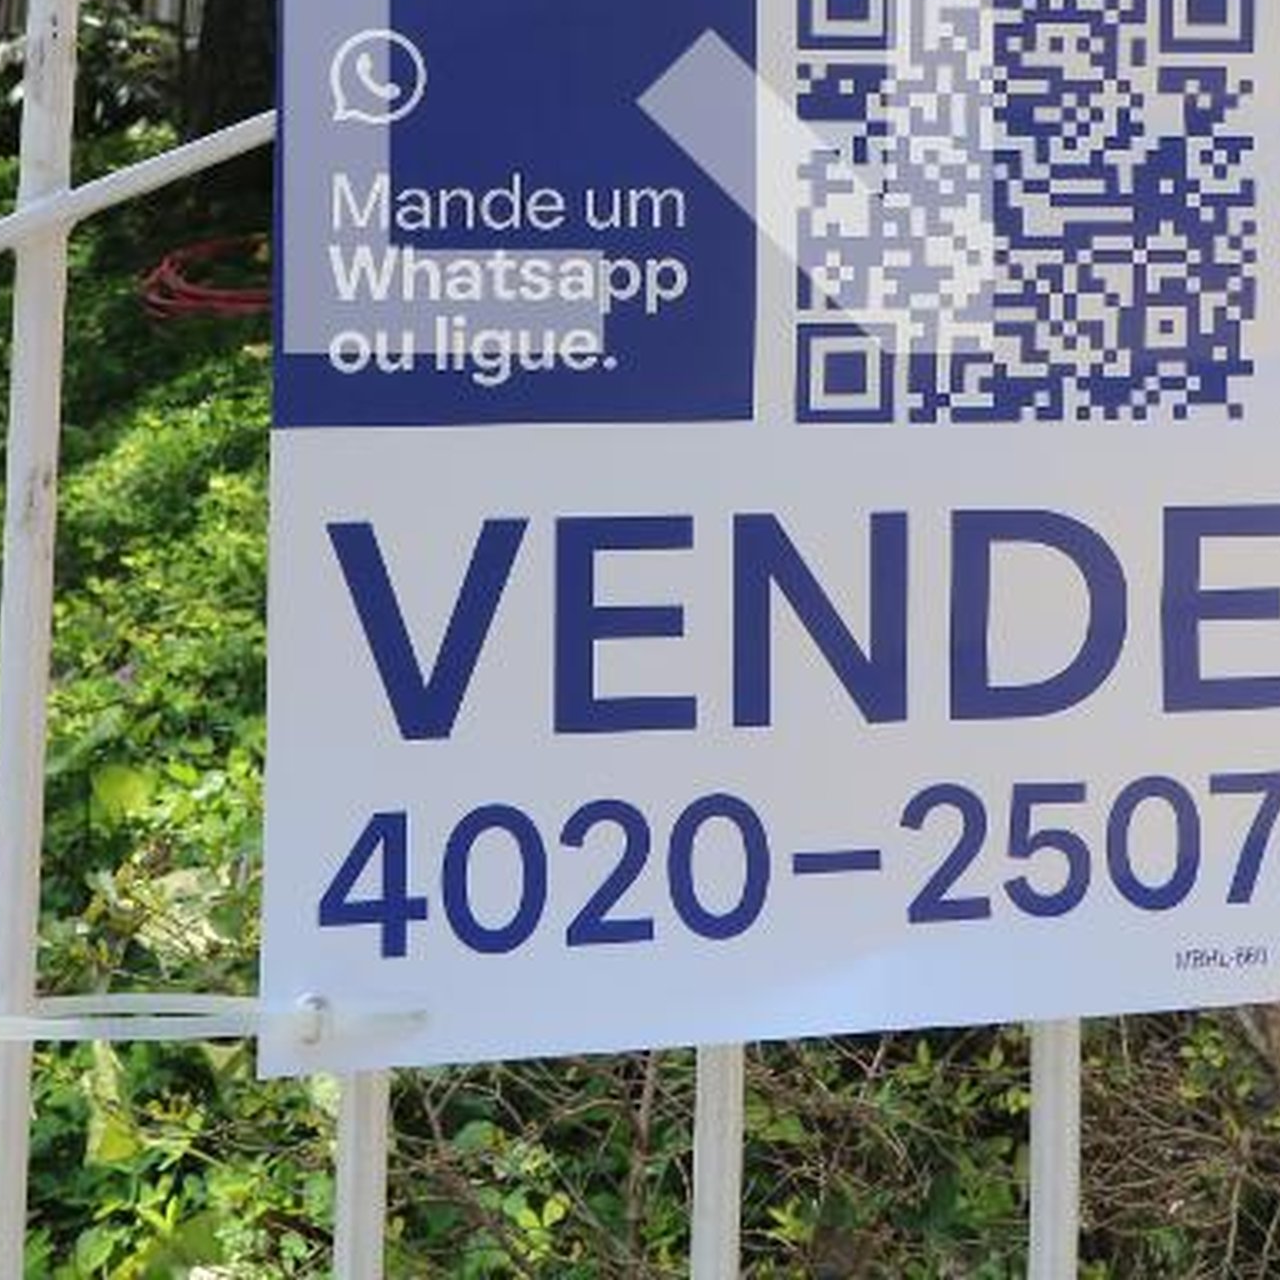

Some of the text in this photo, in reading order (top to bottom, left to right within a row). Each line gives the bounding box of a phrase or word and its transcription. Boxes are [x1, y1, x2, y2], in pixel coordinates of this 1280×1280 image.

[331, 173, 686, 230] Mande um
[328, 245, 689, 314] Whatsapp
[328, 316, 618, 387] ou ligue.
